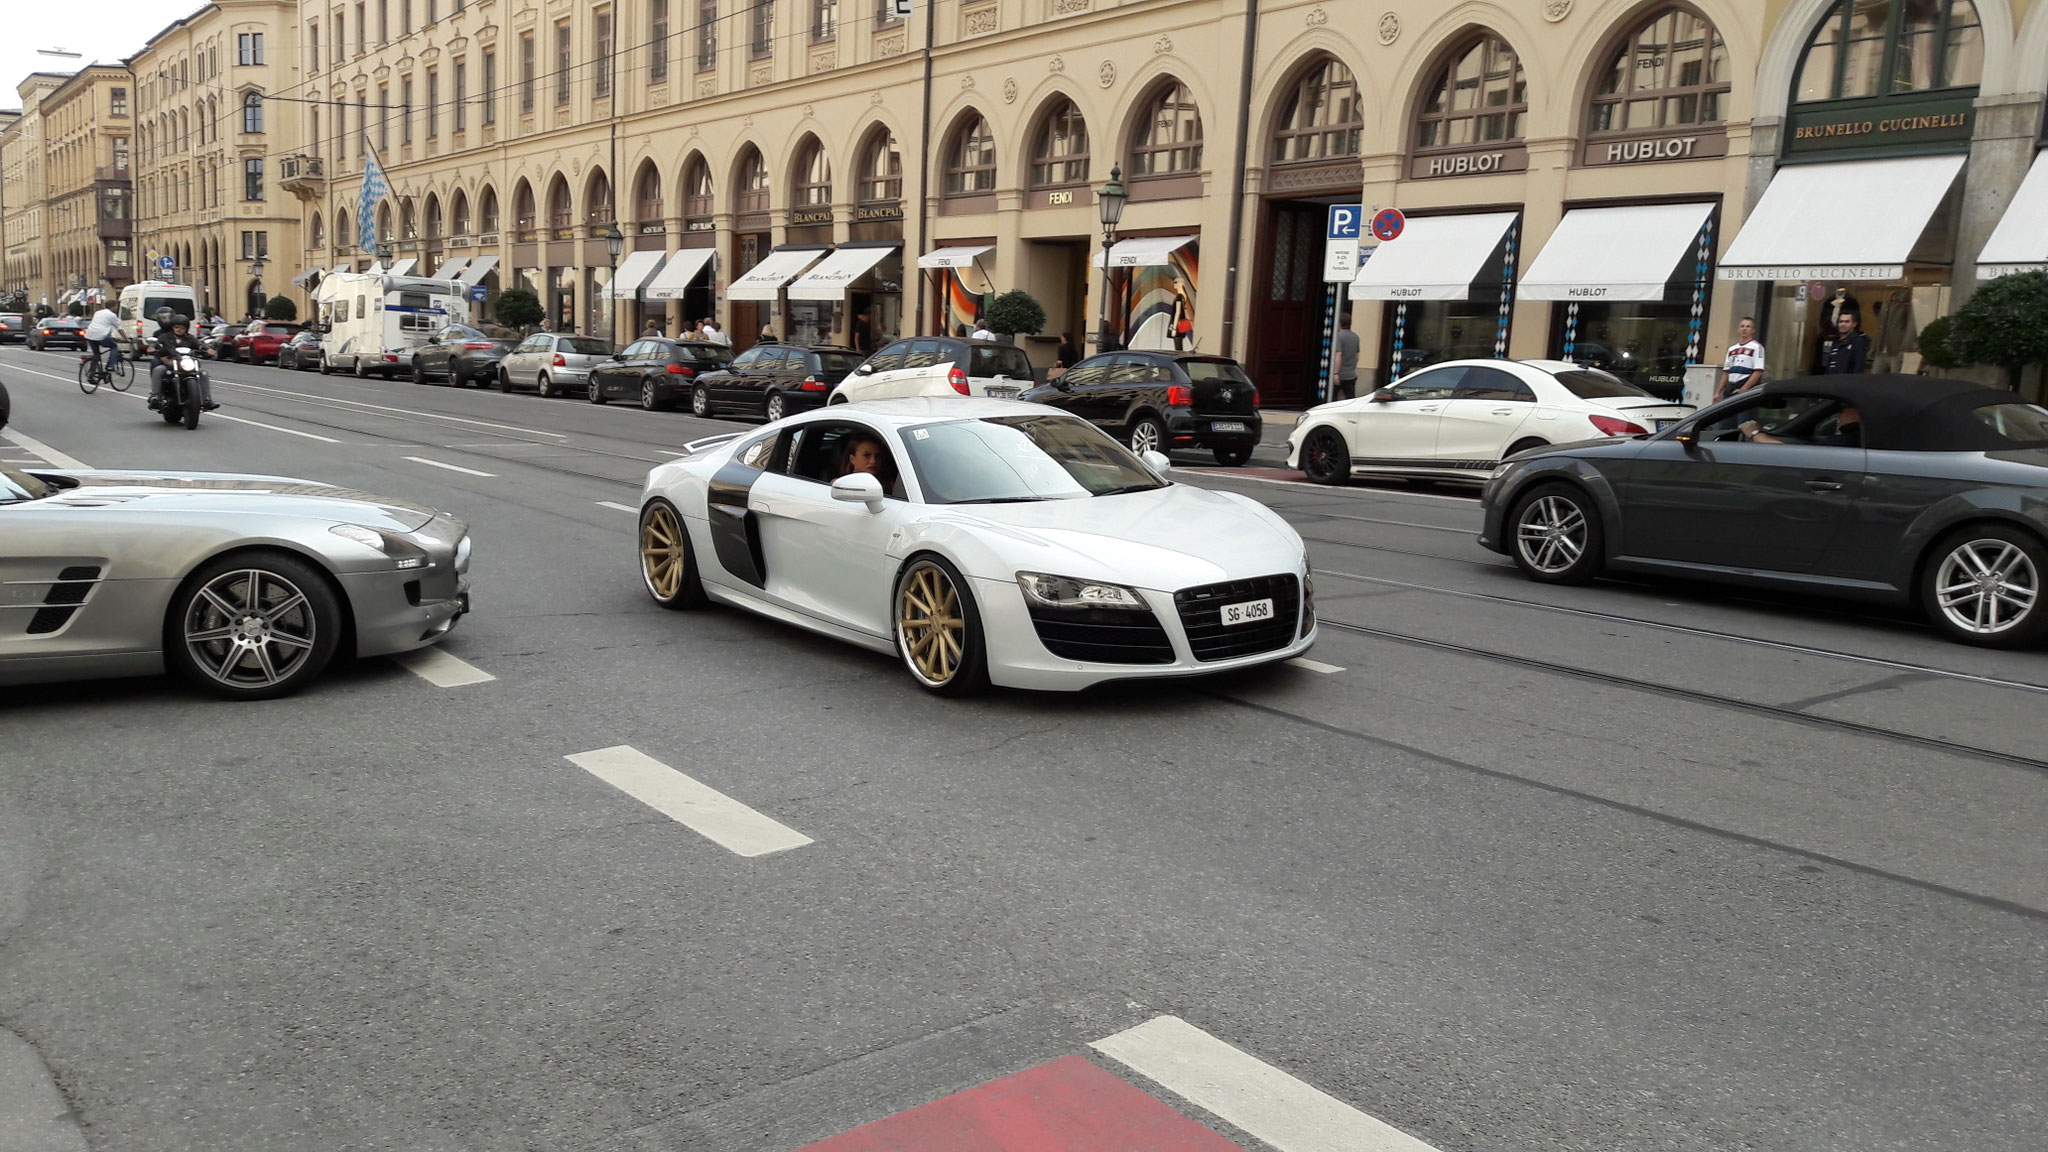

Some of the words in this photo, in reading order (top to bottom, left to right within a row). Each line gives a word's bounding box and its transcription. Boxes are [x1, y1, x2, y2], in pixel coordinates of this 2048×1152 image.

[1796, 121, 1873, 139] BRUNELLO
[1879, 113, 1966, 132] CUCINELLI
[1607, 137, 1696, 162] HUBLOT
[1429, 154, 1503, 175] HUBLOT
[1049, 192, 1073, 205] FENDI
[1333, 209, 1352, 234] P
[1120, 256, 1137, 265] FENDI
[1728, 269, 1801, 279] BRUNELLO
[1810, 268, 1892, 279] CUCINELLI
[1390, 288, 1422, 297] HUBLOT
[1568, 288, 1607, 297] HUBLOT
[1648, 375, 1681, 383] HUBLOT
